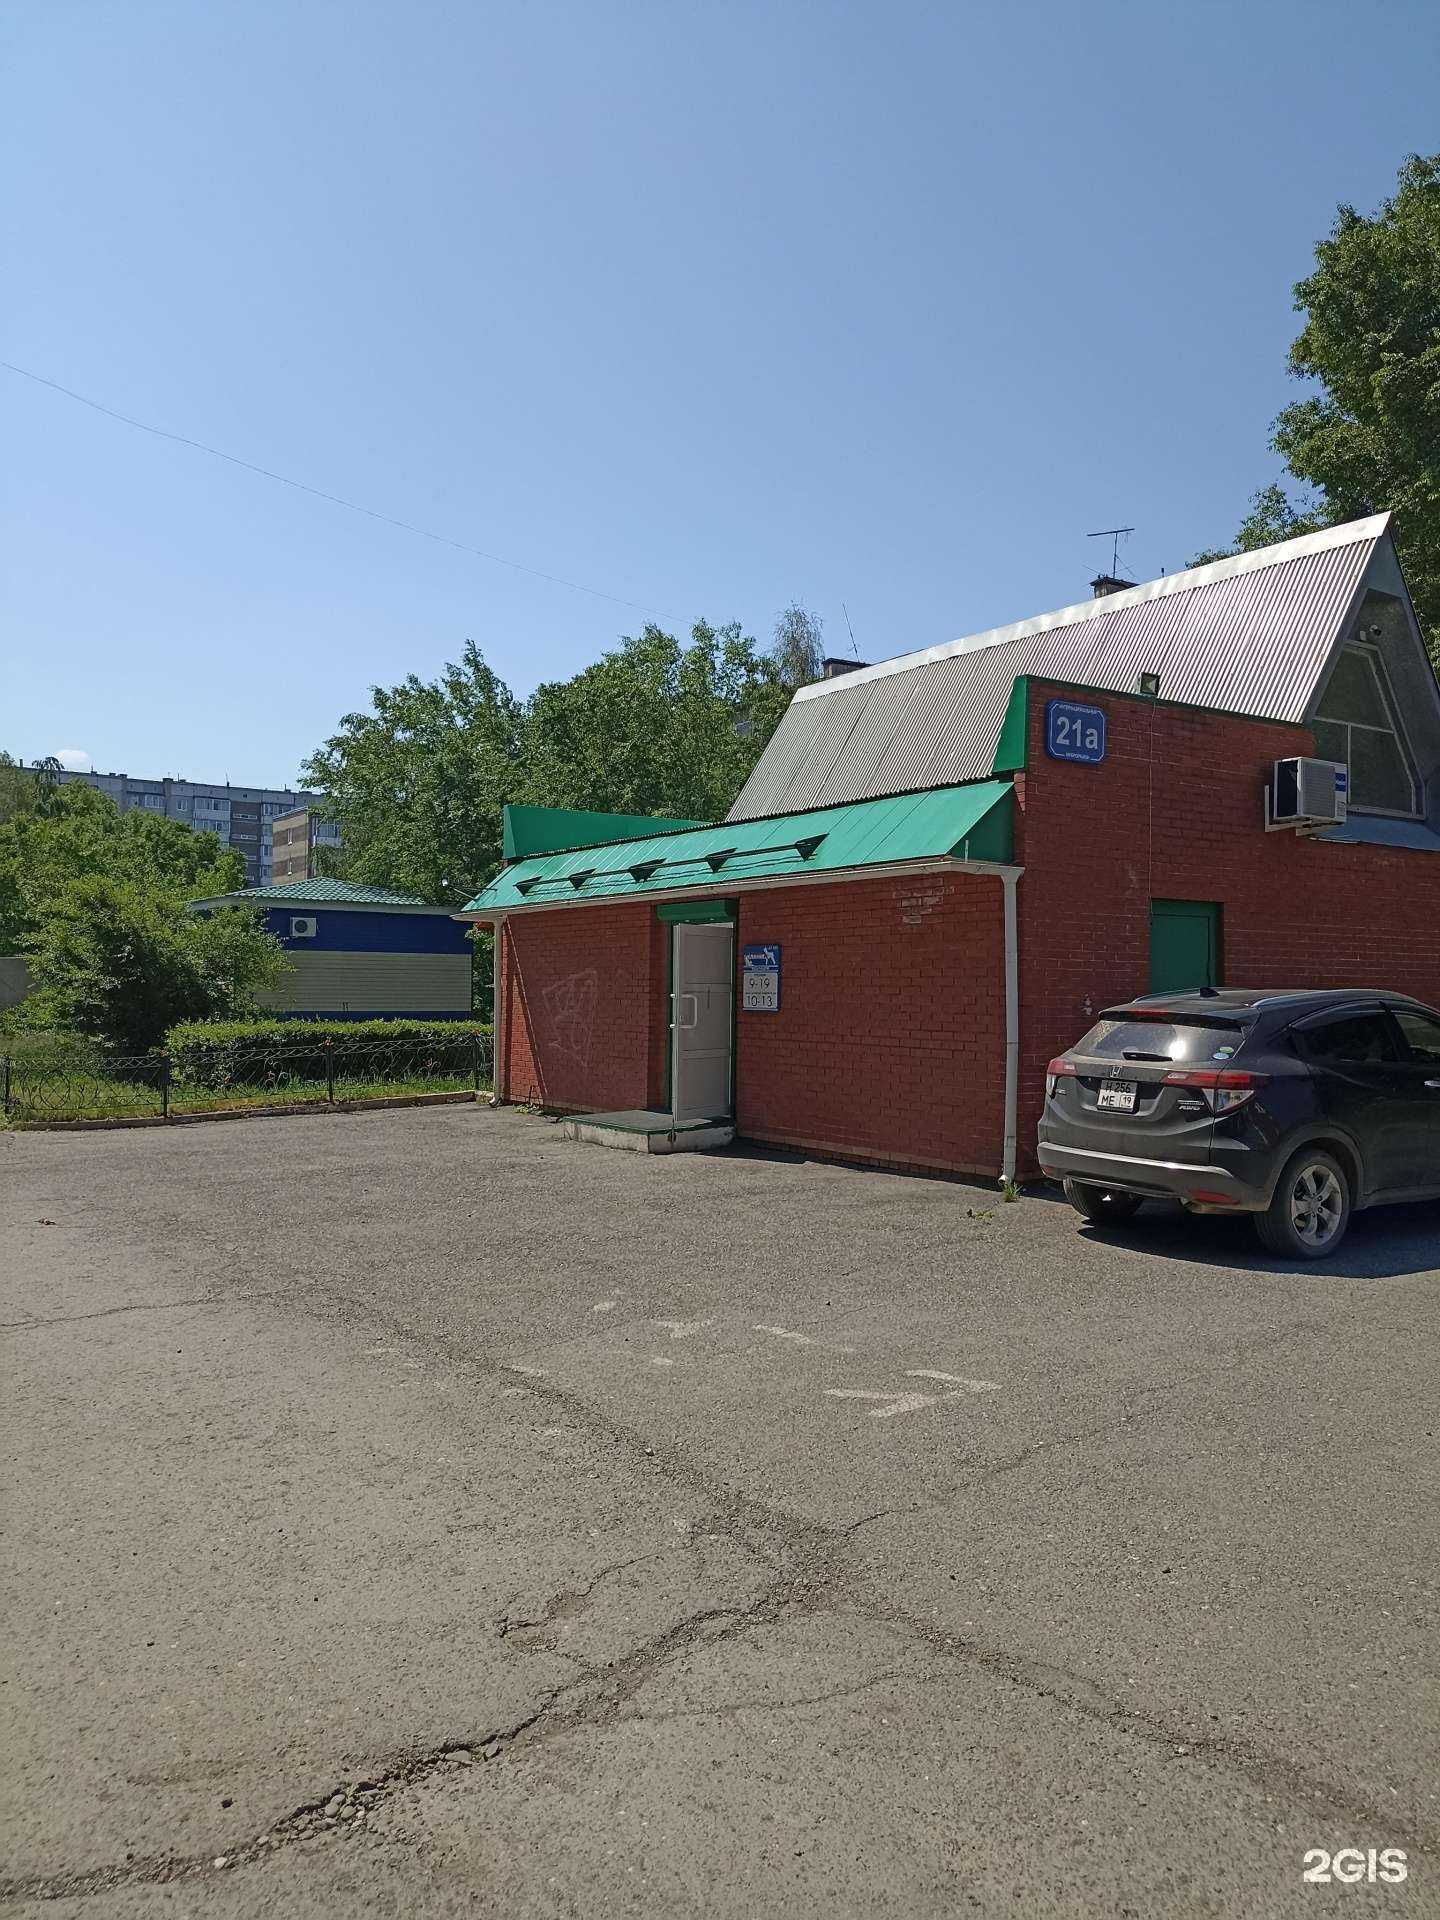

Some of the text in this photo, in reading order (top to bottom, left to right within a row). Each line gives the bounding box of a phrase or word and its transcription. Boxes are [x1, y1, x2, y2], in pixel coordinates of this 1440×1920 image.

[749, 978, 769, 989] 9-19
[747, 995, 773, 1007] 10-13
[1114, 1082, 1131, 1093] 256
[1123, 1096, 1132, 1105] 19
